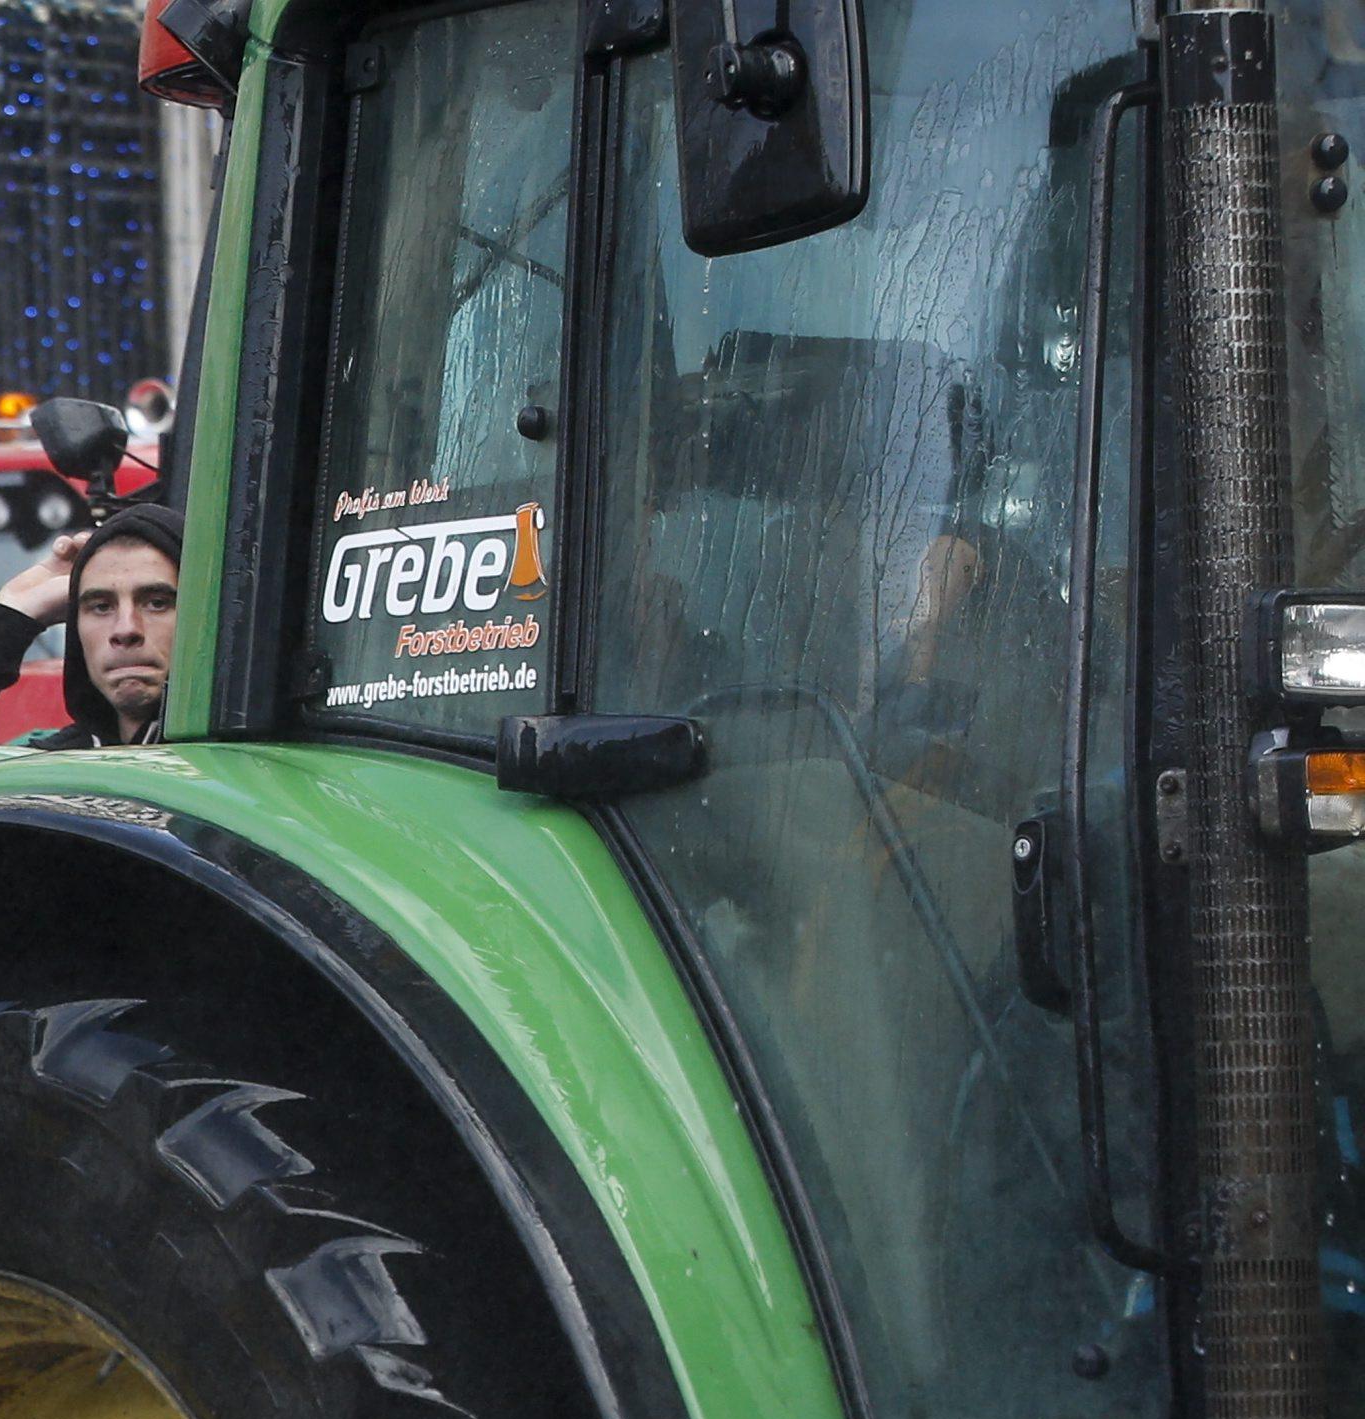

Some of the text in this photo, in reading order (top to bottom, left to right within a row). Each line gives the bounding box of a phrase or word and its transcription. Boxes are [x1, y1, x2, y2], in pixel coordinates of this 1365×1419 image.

[381, 489, 406, 510] am
[409, 476, 450, 506] Werk
[322, 516, 517, 623] Grebe
[394, 613, 540, 659] Forstbetrieb
[326, 661, 537, 709] www.grebe-forstbetrieb.de
